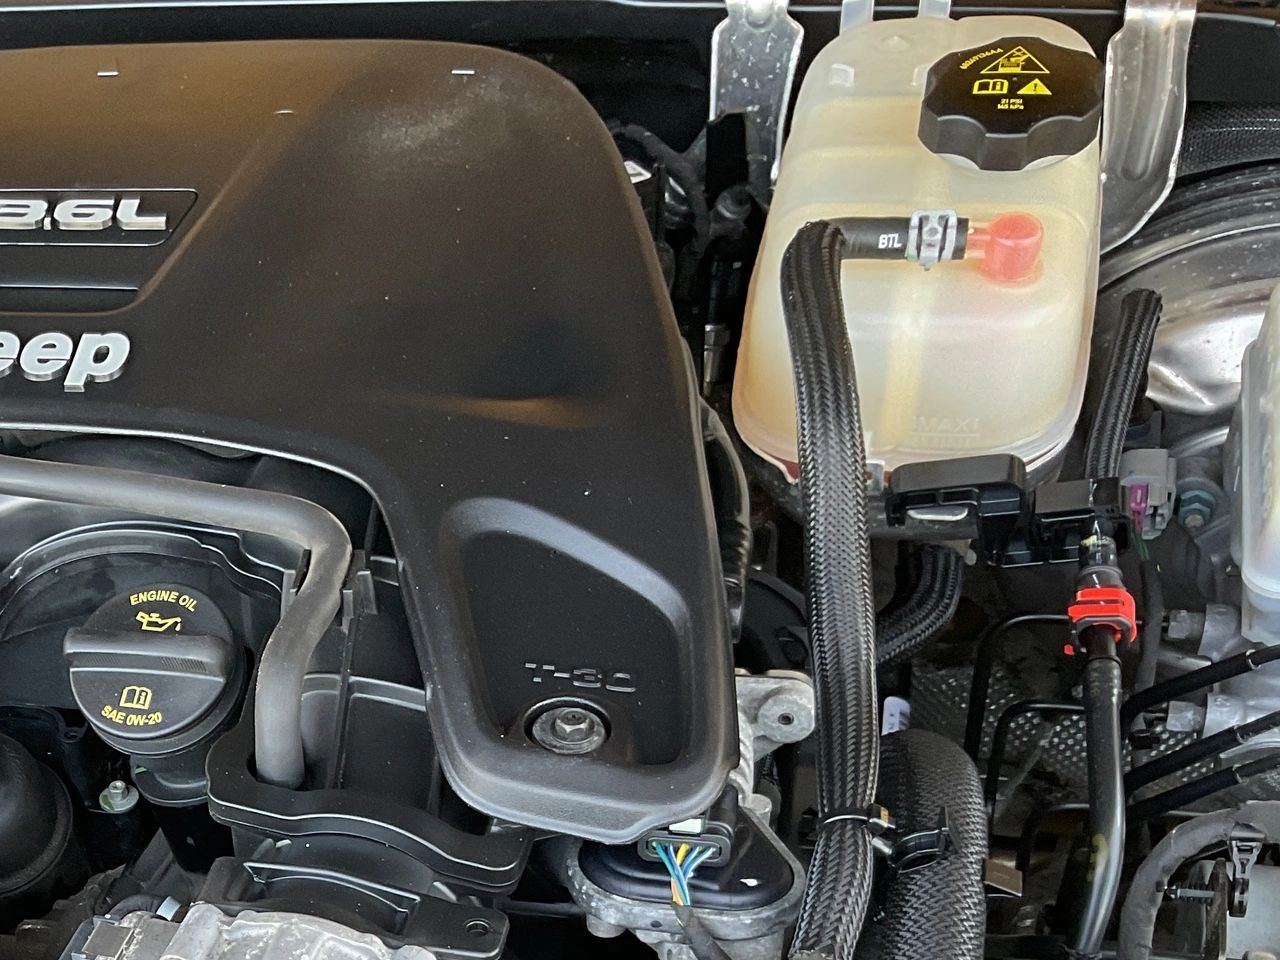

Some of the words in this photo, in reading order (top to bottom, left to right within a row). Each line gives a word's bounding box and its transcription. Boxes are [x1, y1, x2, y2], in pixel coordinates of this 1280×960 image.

[878, 233, 902, 249] BTL
[129, 590, 179, 606] ENGINE
[178, 595, 199, 612] OIL
[101, 705, 126, 724] SAE
[126, 711, 162, 726] 0W-20
